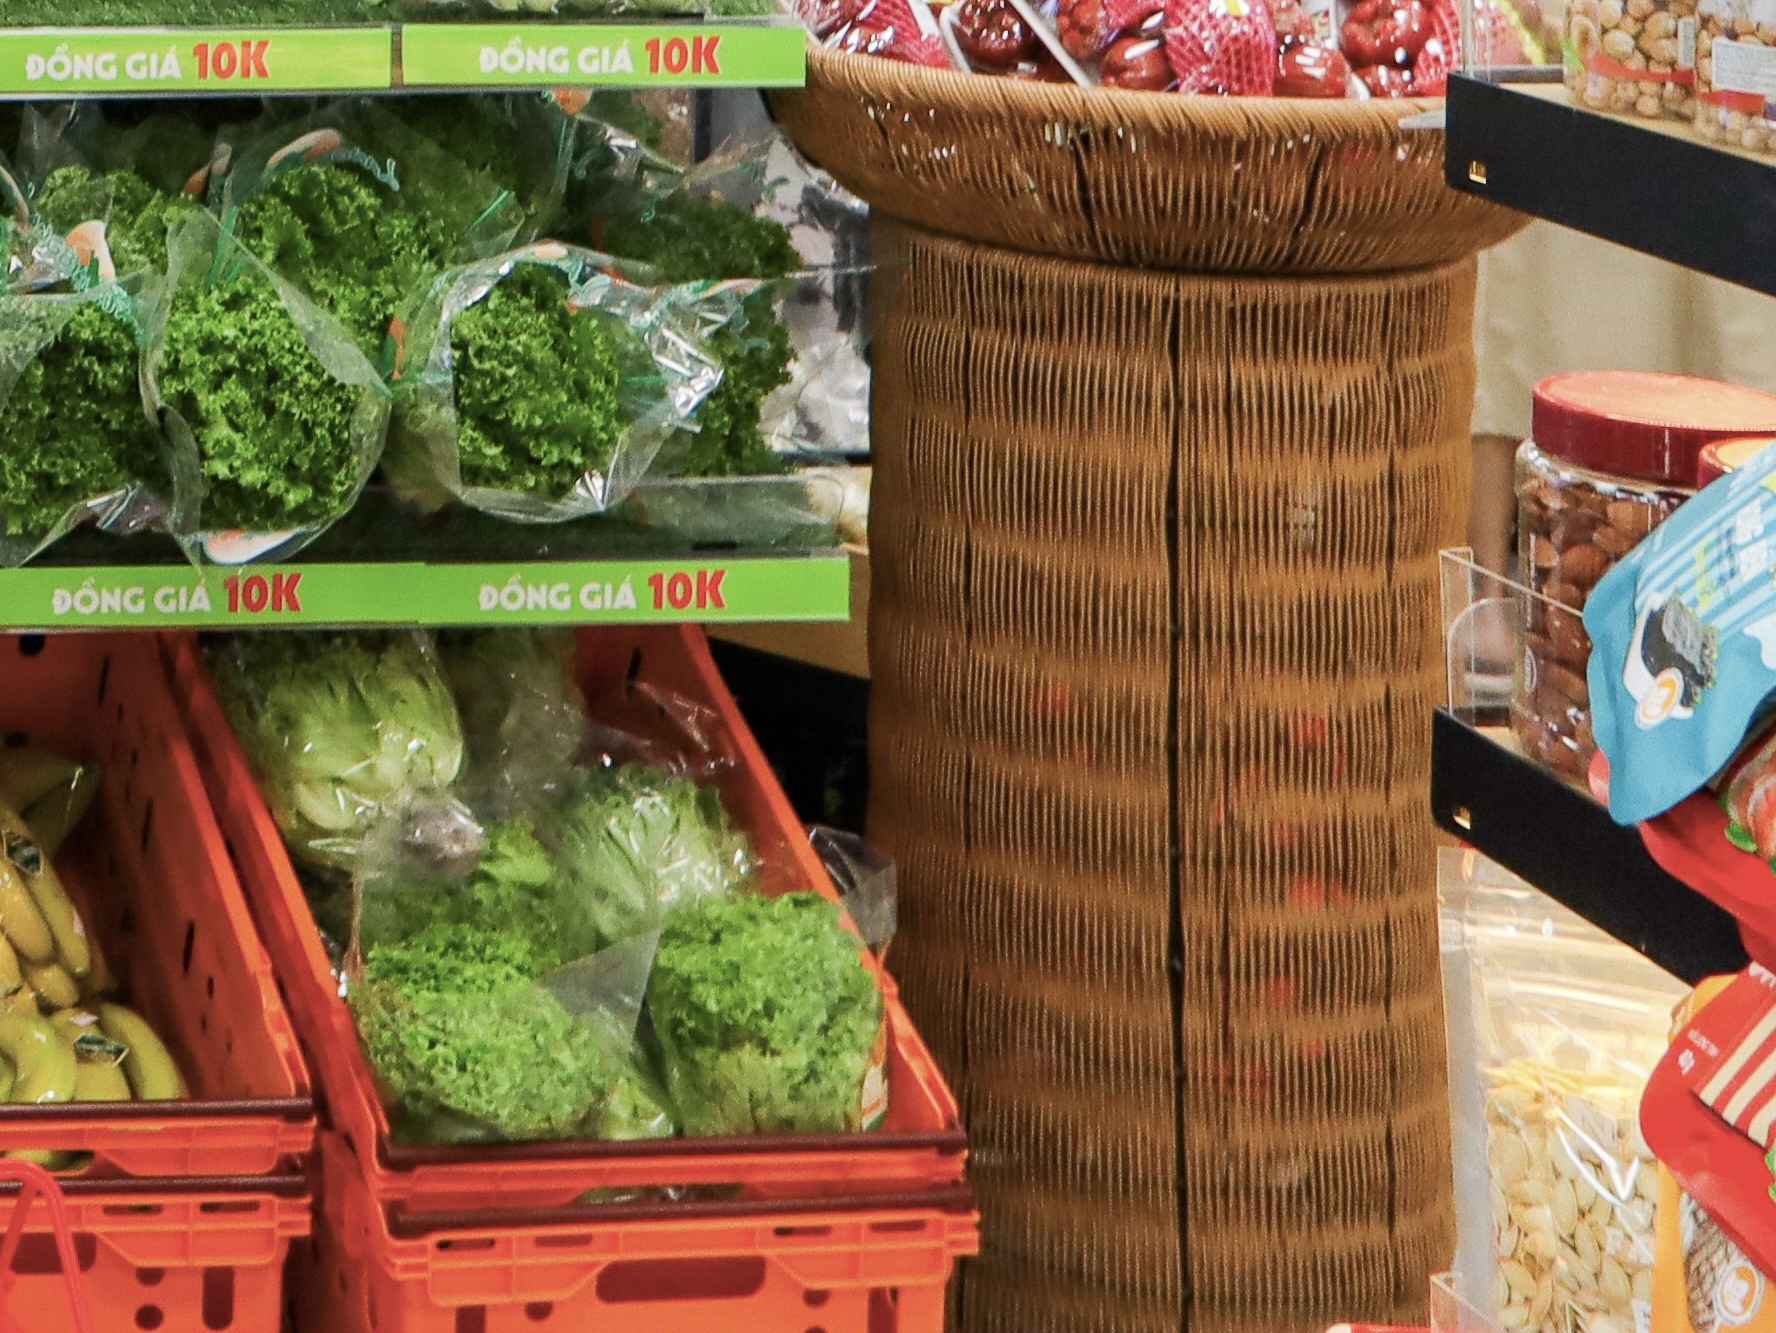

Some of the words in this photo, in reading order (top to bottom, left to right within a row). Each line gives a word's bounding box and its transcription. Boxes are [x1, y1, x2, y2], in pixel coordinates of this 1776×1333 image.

[25, 44, 118, 81] ĐỒNG
[124, 46, 183, 79] GIÁ
[192, 40, 270, 80] 10K
[479, 38, 570, 74] ĐỒNG
[577, 39, 633, 74] GIÁ
[644, 35, 721, 75] 10K
[52, 578, 146, 616] ĐỒNG
[153, 578, 211, 614] GIÁ
[223, 573, 302, 614] 10K
[478, 575, 571, 612] ĐỒNG
[578, 575, 636, 611] GIÁ
[648, 570, 727, 610] 10K
